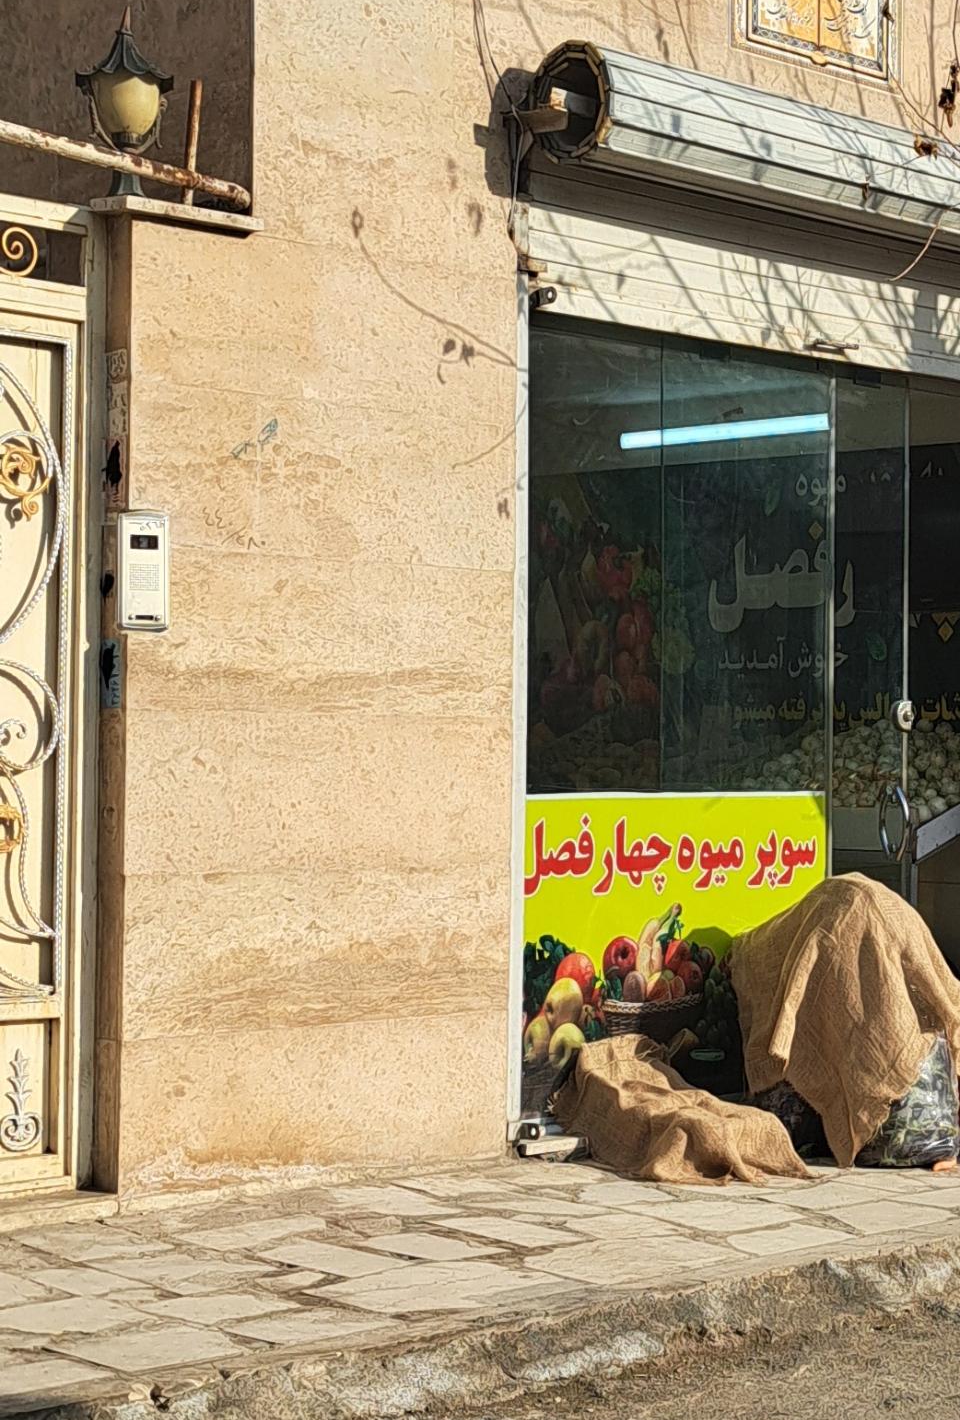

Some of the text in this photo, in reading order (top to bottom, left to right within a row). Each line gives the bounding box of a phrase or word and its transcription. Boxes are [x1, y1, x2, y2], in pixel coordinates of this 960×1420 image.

[717, 635, 786, 679] آمدید
[524, 813, 818, 898] سوپر میوه چهار فصل
